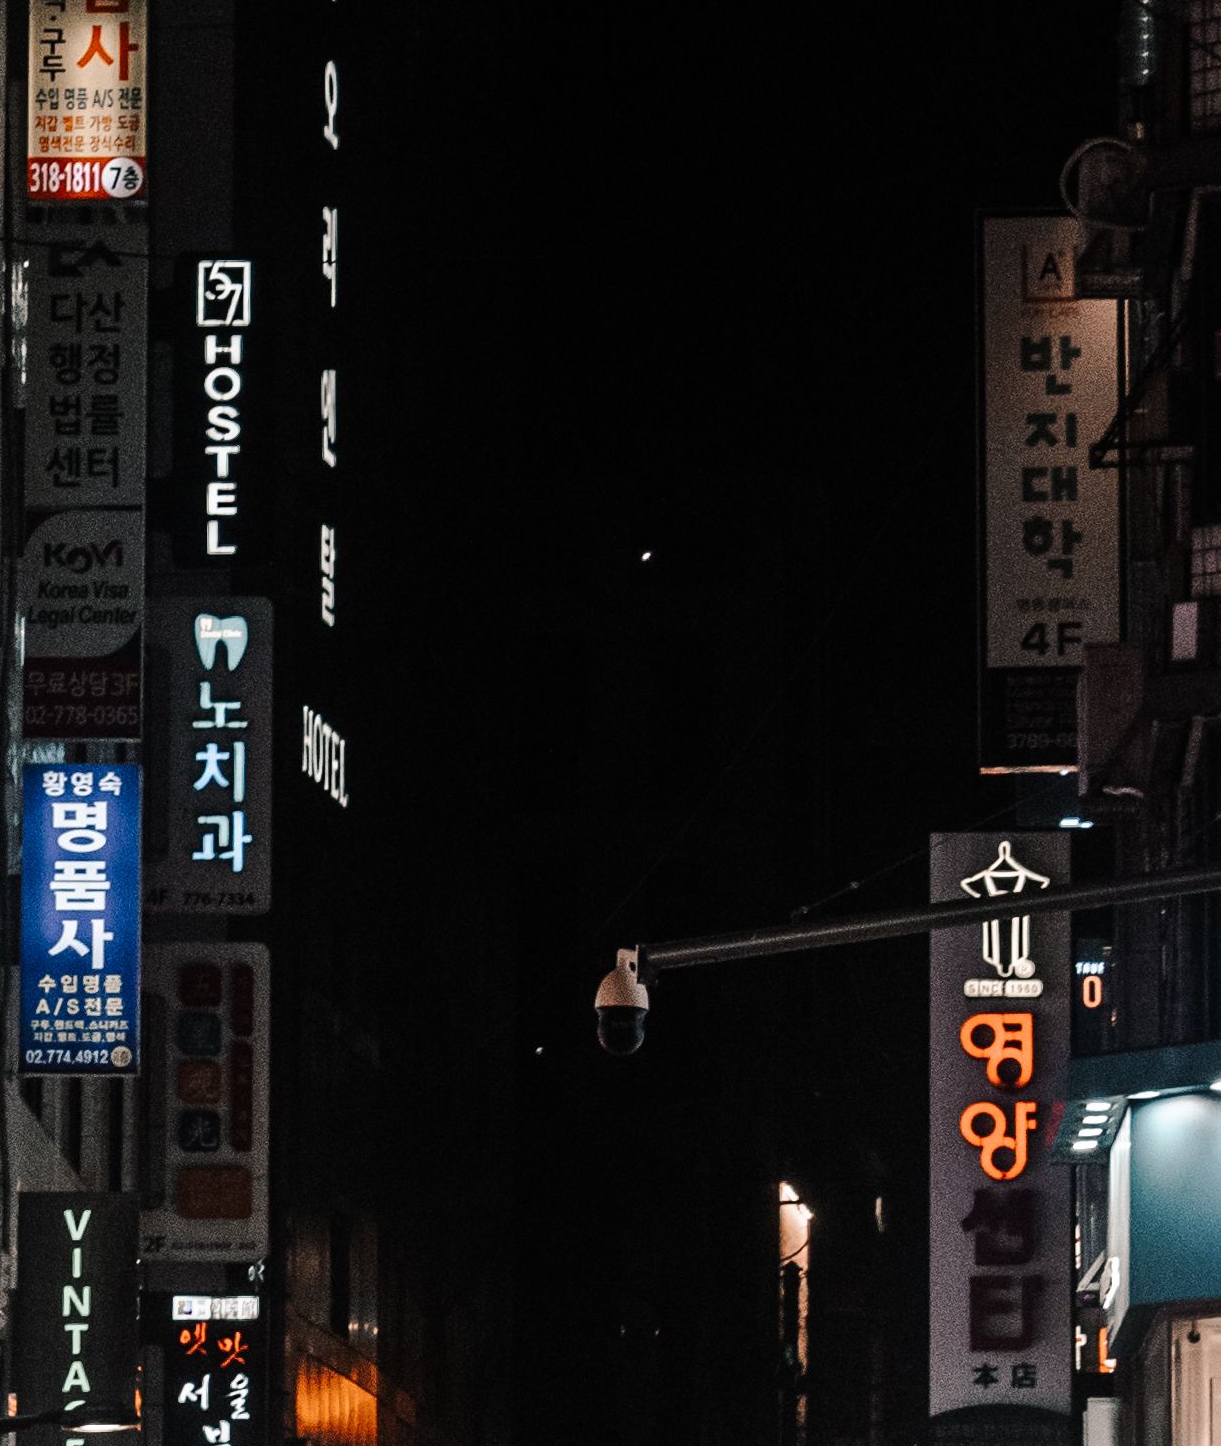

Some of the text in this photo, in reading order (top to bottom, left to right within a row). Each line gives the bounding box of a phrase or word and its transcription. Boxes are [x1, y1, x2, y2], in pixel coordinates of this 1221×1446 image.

[35, 87, 59, 111] 수입
[92, 89, 114, 109] A/S
[30, 161, 101, 193] 318-1811
[49, 292, 125, 334] 다산
[48, 343, 121, 385] 행정
[204, 334, 242, 556] HOSTEL
[1021, 336, 1082, 579] 반지대학
[45, 446, 120, 489] 센터
[37, 581, 129, 600] Korea Visa
[28, 606, 137, 629] Legal Center
[1021, 621, 1083, 657] 4F
[192, 681, 253, 874] 노치과
[302, 705, 350, 808] HOTEL
[42, 770, 122, 797] 황영숙
[48, 800, 114, 970] 명품사
[959, 1012, 1042, 1352] 영양센터
[972, 1361, 1037, 1389] 本店
